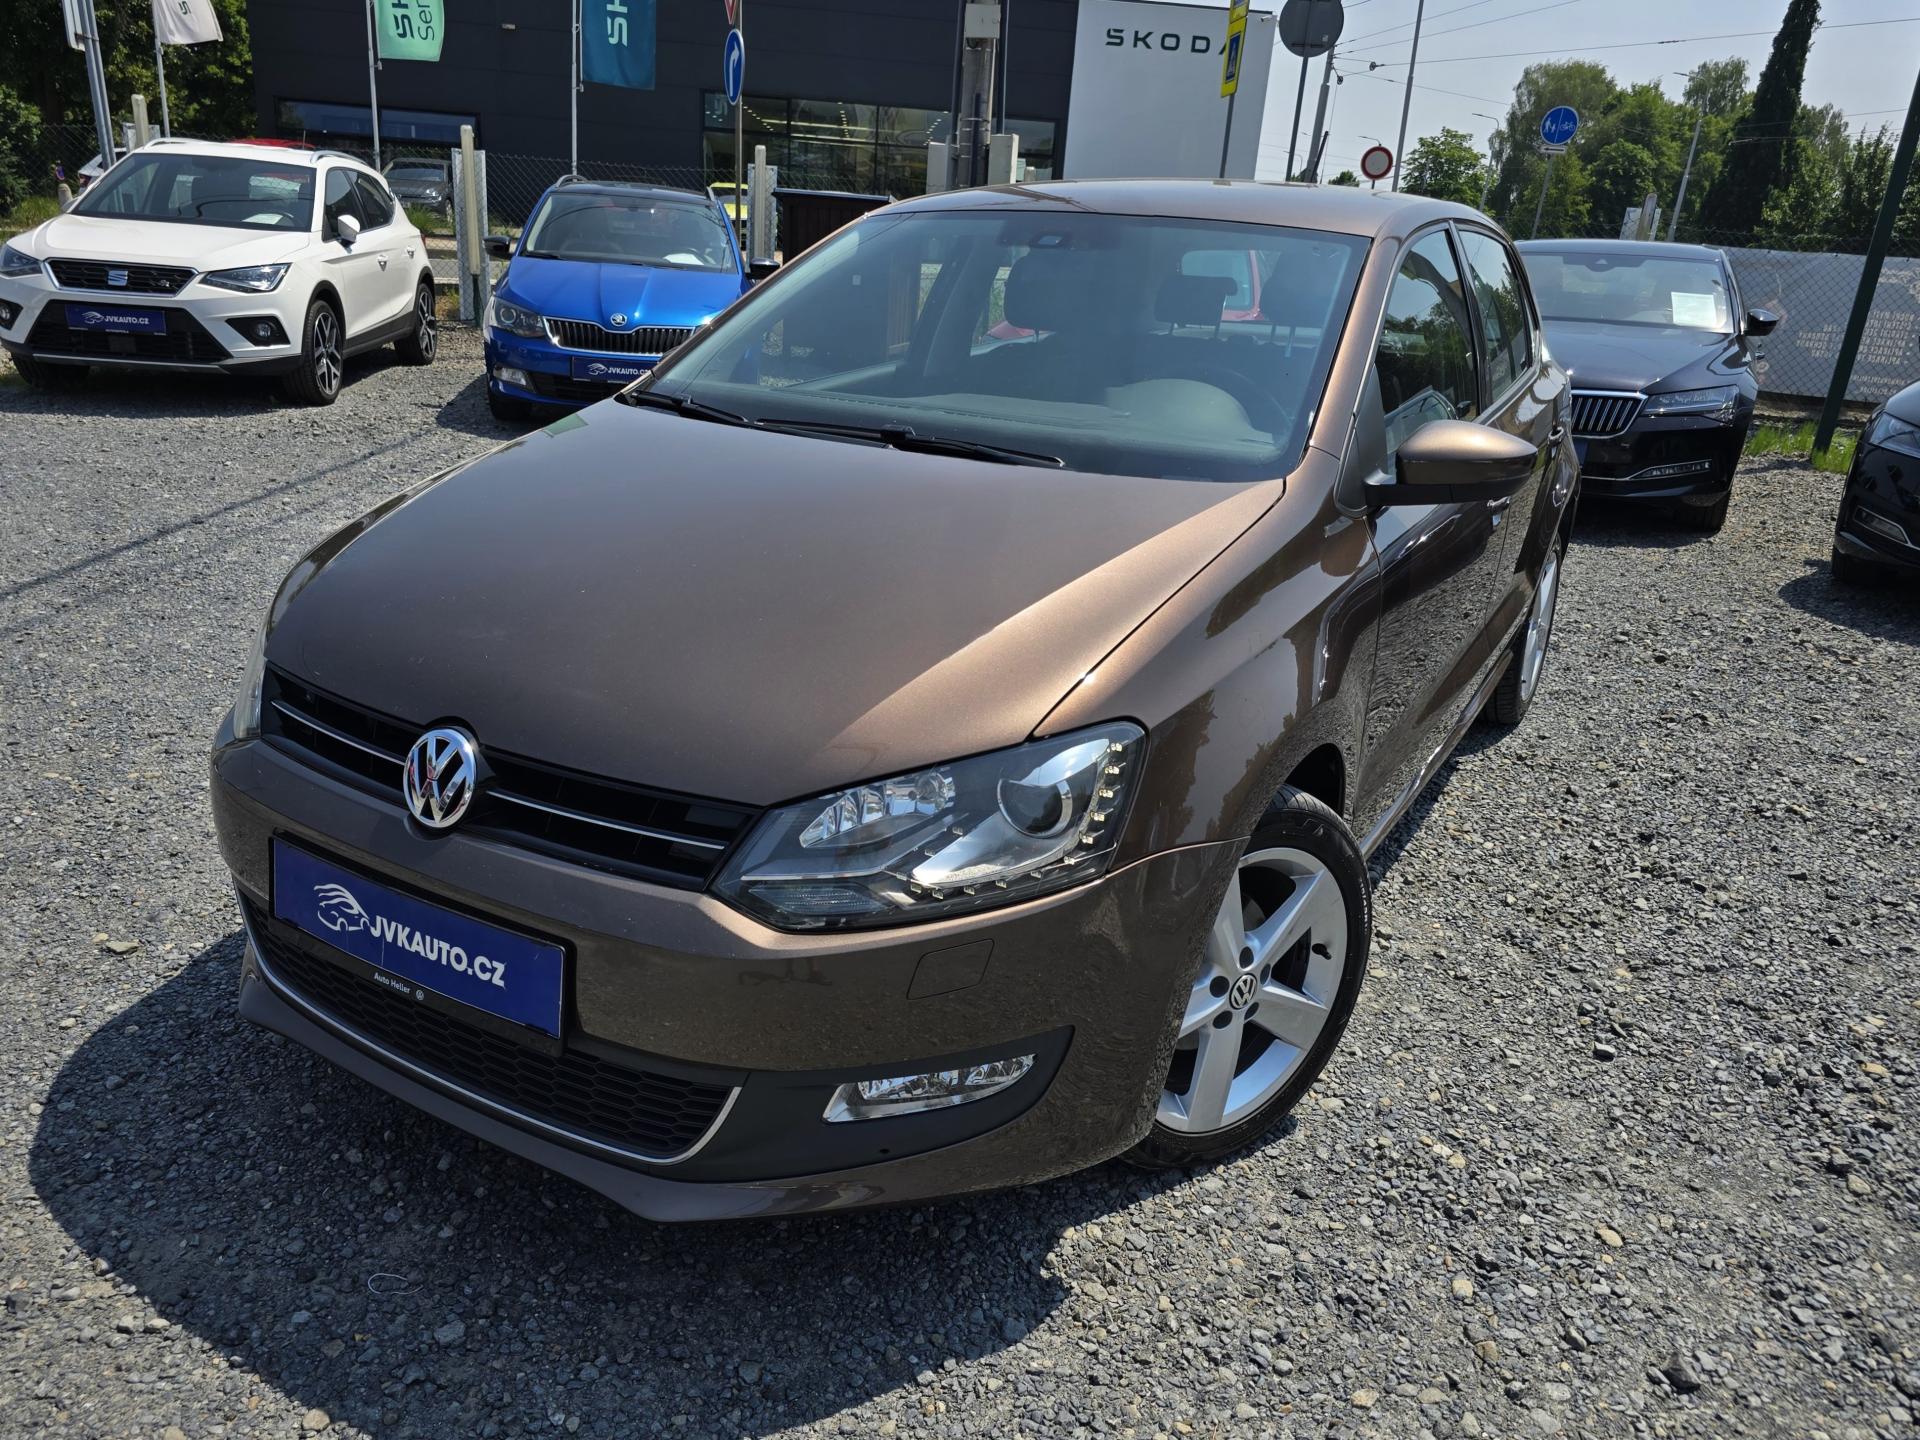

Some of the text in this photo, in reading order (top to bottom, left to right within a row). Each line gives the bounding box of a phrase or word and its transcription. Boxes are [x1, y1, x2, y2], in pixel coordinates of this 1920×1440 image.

[104, 315, 150, 325] JVKAUTO.CZ
[369, 914, 507, 988] JVKAUTO.CZ
[373, 972, 390, 985] Auto
[390, 979, 411, 994] Heller
